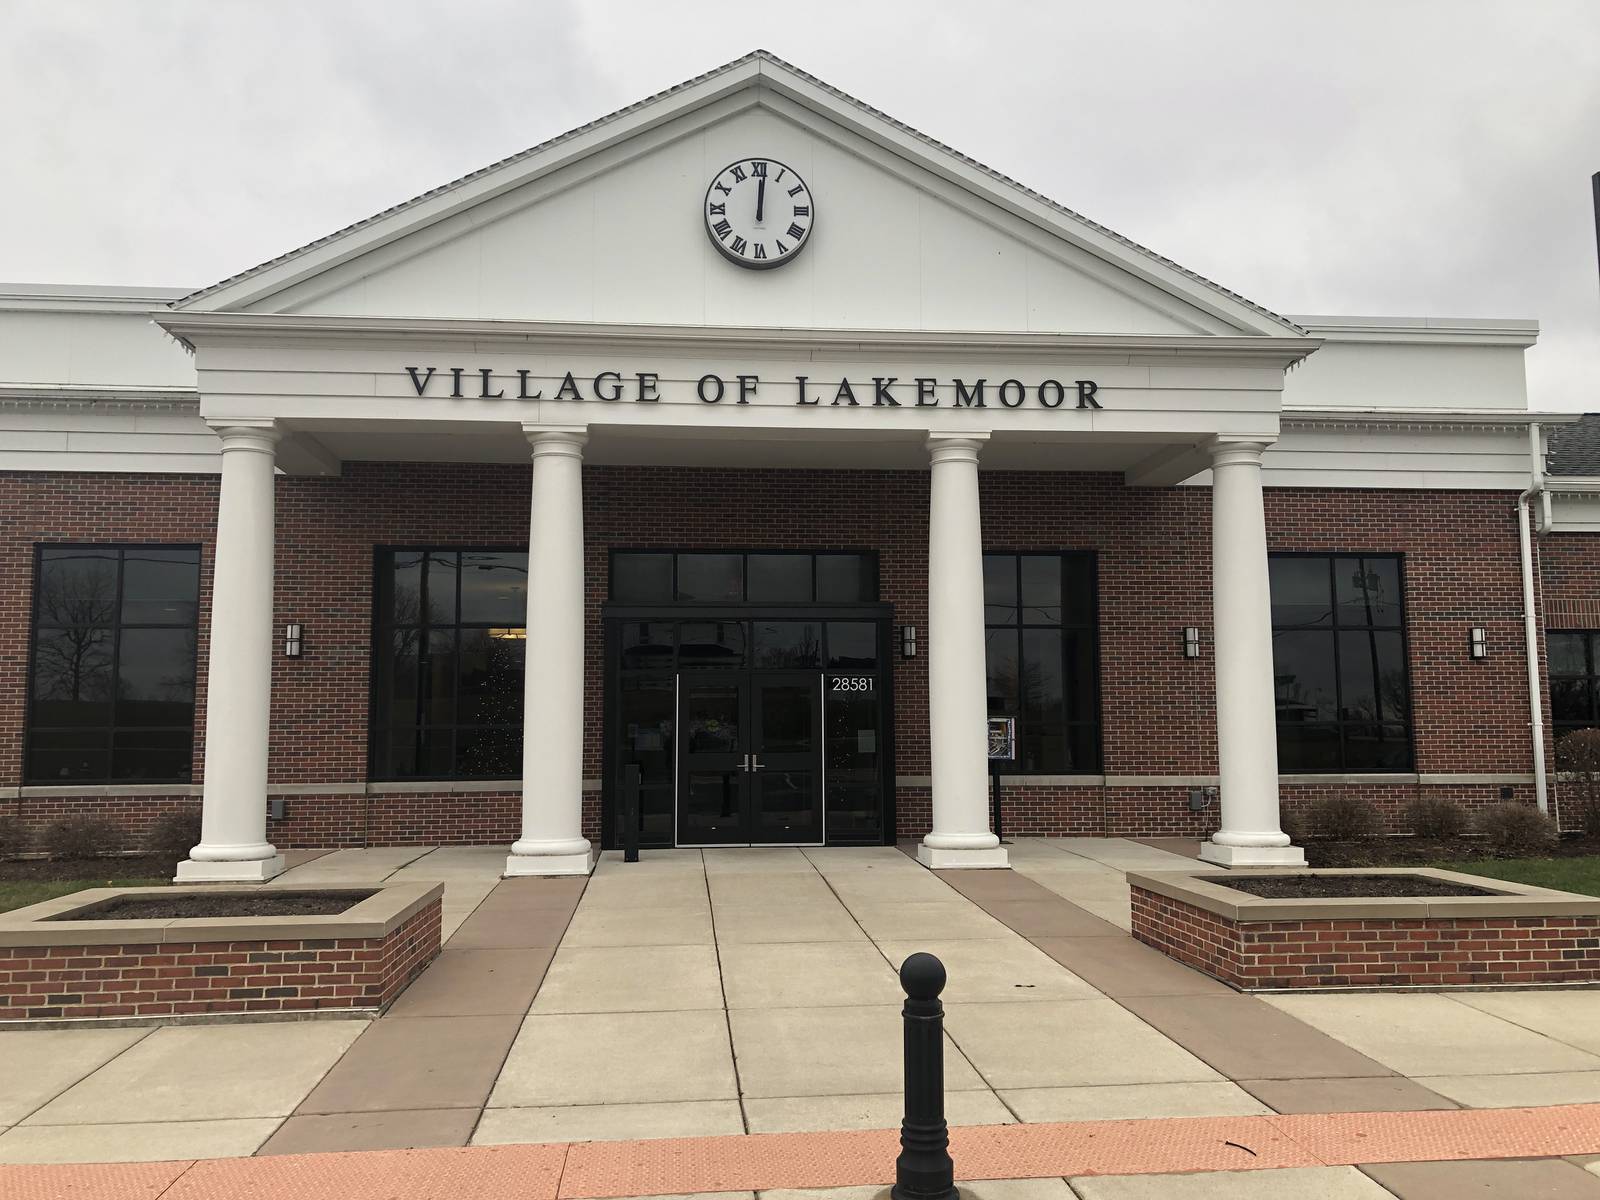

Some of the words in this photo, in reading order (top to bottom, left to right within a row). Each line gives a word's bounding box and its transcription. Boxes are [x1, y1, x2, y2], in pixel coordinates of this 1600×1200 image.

[730, 165, 747, 183] XI
[751, 161, 767, 177] XII
[775, 168, 785, 183] I
[715, 181, 732, 196] X
[788, 184, 804, 197] II
[710, 203, 725, 215] IX
[794, 205, 809, 217] III
[713, 218, 732, 241] VIII
[786, 222, 805, 241] IIII
[729, 235, 747, 256] VII
[754, 243, 767, 258] VI
[776, 239, 788, 254] V
[405, 366, 660, 403] VILLAGE
[697, 375, 760, 405] OF
[796, 376, 1103, 410] LAKEMOOR
[832, 677, 873, 692] 28581
